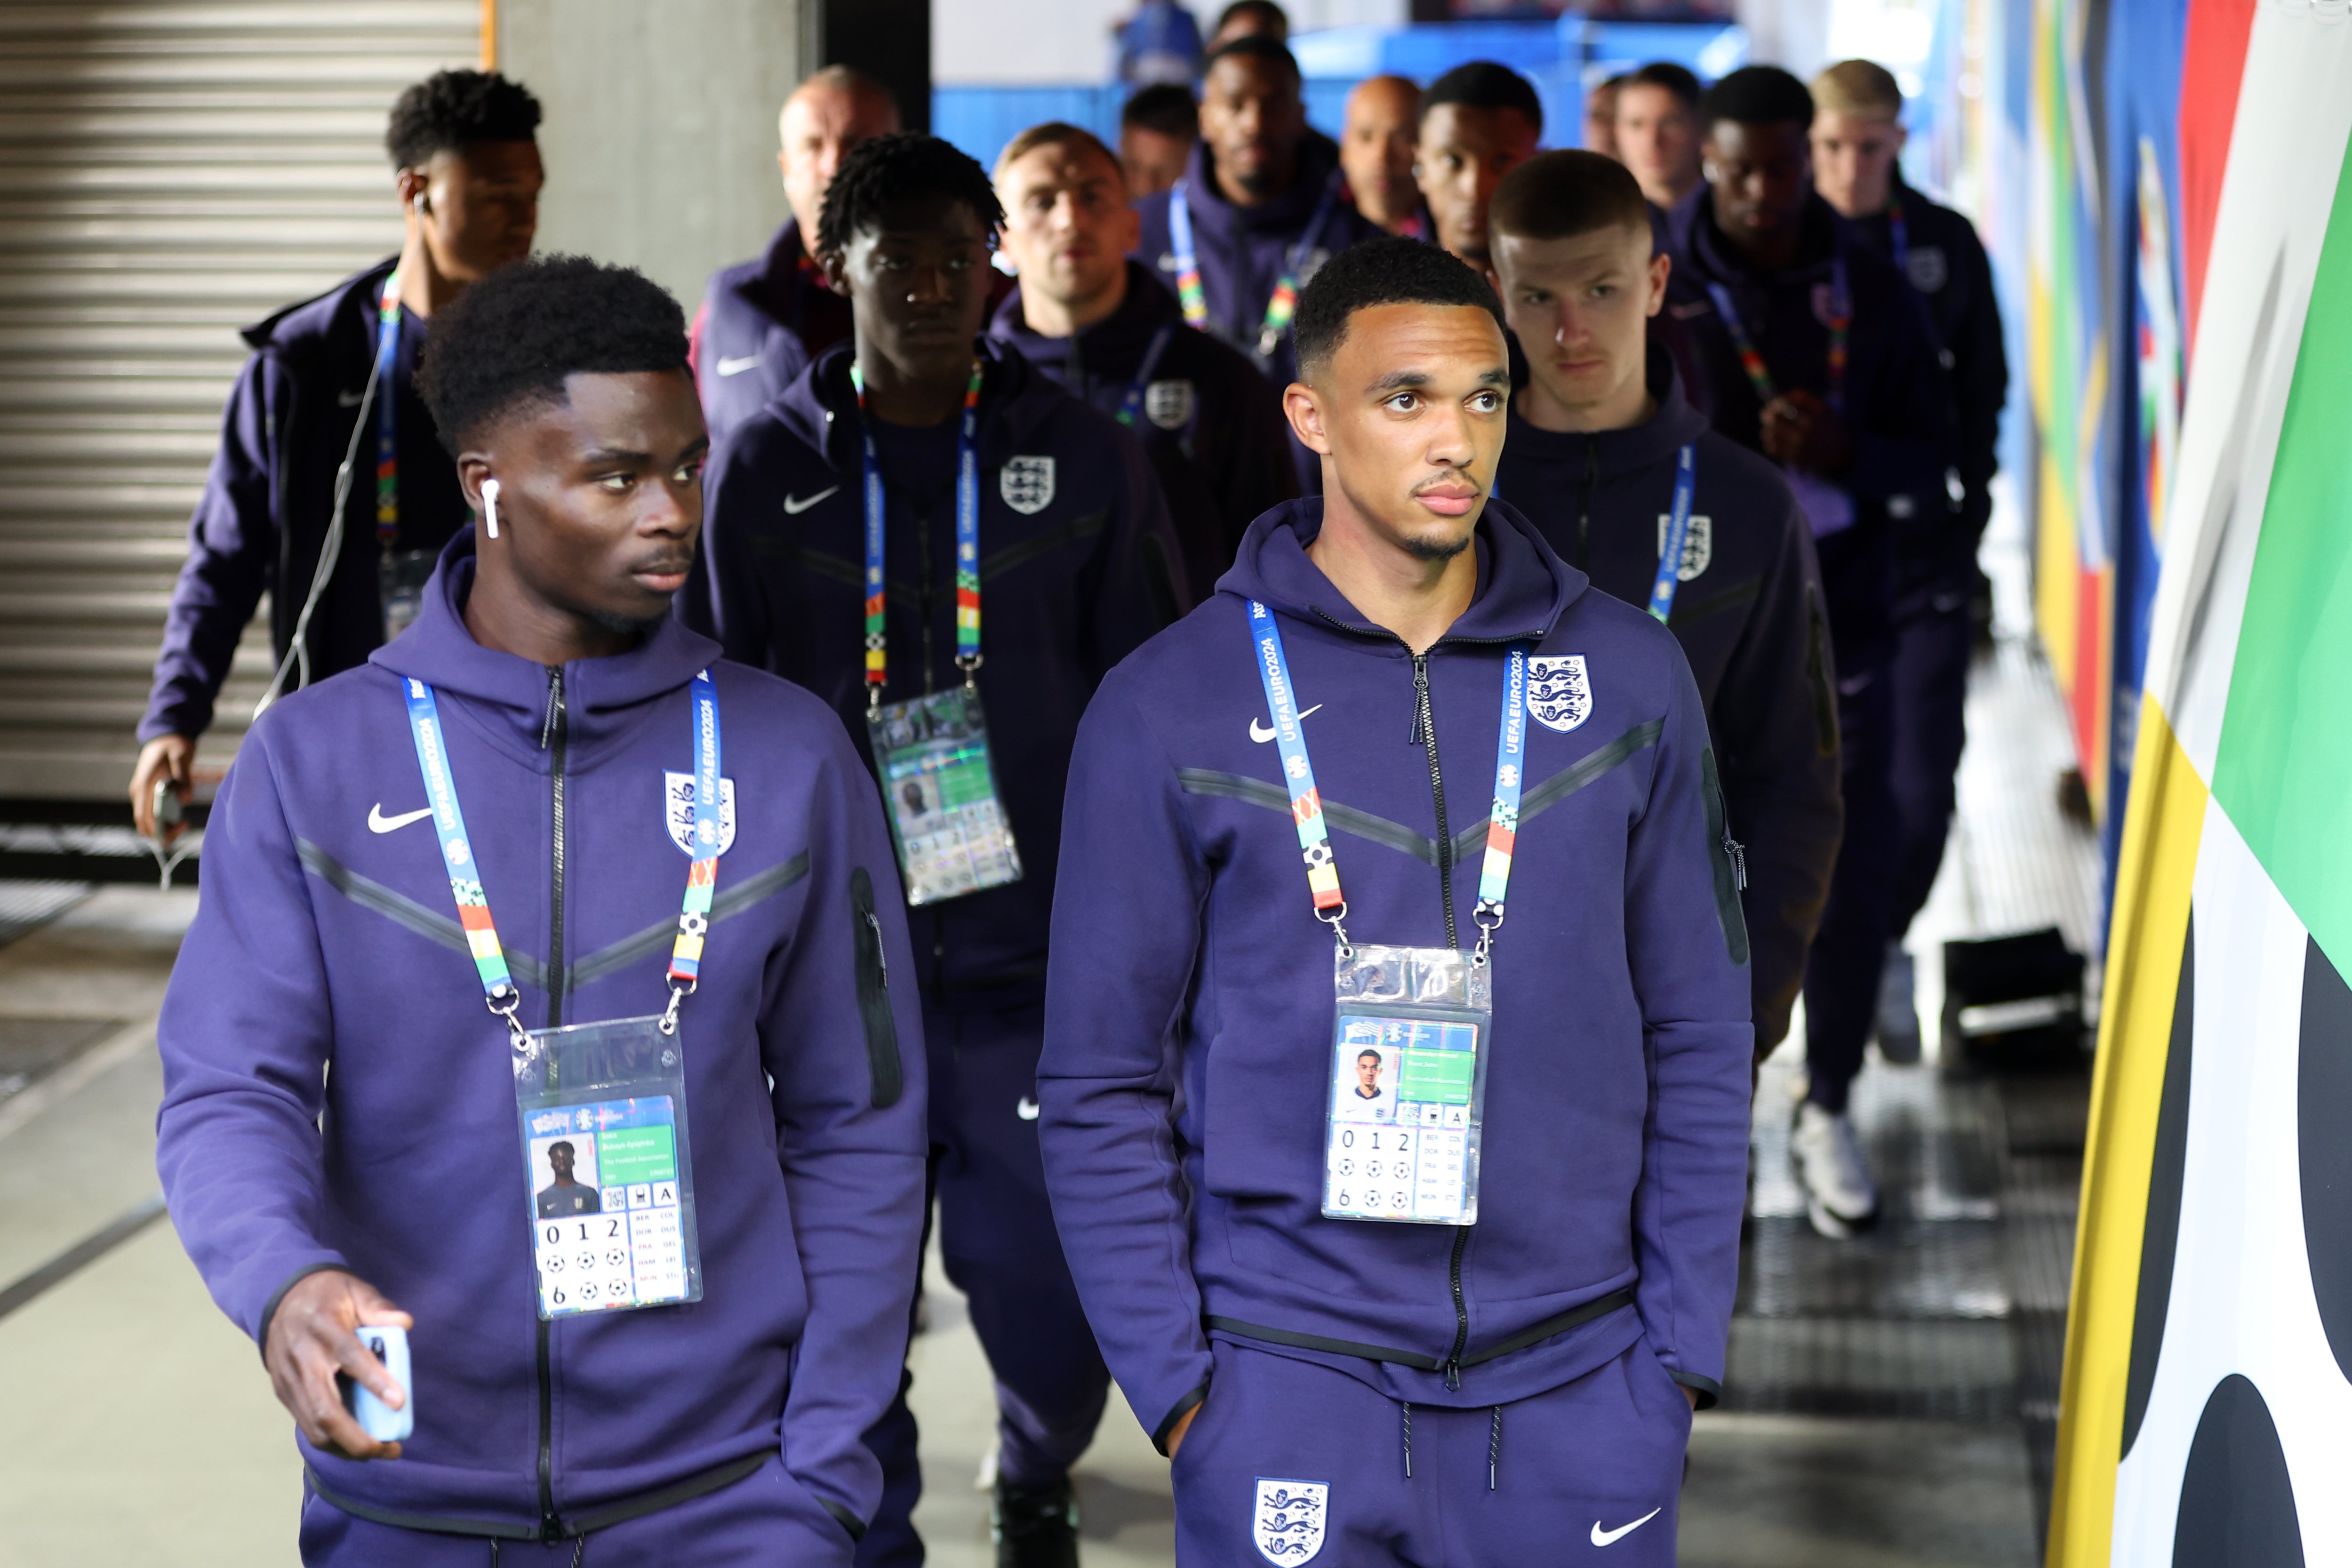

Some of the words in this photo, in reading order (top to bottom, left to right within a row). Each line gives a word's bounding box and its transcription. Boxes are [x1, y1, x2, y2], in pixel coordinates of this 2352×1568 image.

[1452, 1112, 1461, 1124] A
[1343, 1130, 1354, 1148] 0
[1372, 1132, 1380, 1149] 1
[1399, 1134, 1408, 1151] 2
[661, 1188, 672, 1200] A
[1339, 1189, 1350, 1206] 6
[547, 1226, 560, 1244] 0
[578, 1223, 589, 1240] 1
[607, 1219, 619, 1237] 2
[553, 1285, 566, 1304] 6
